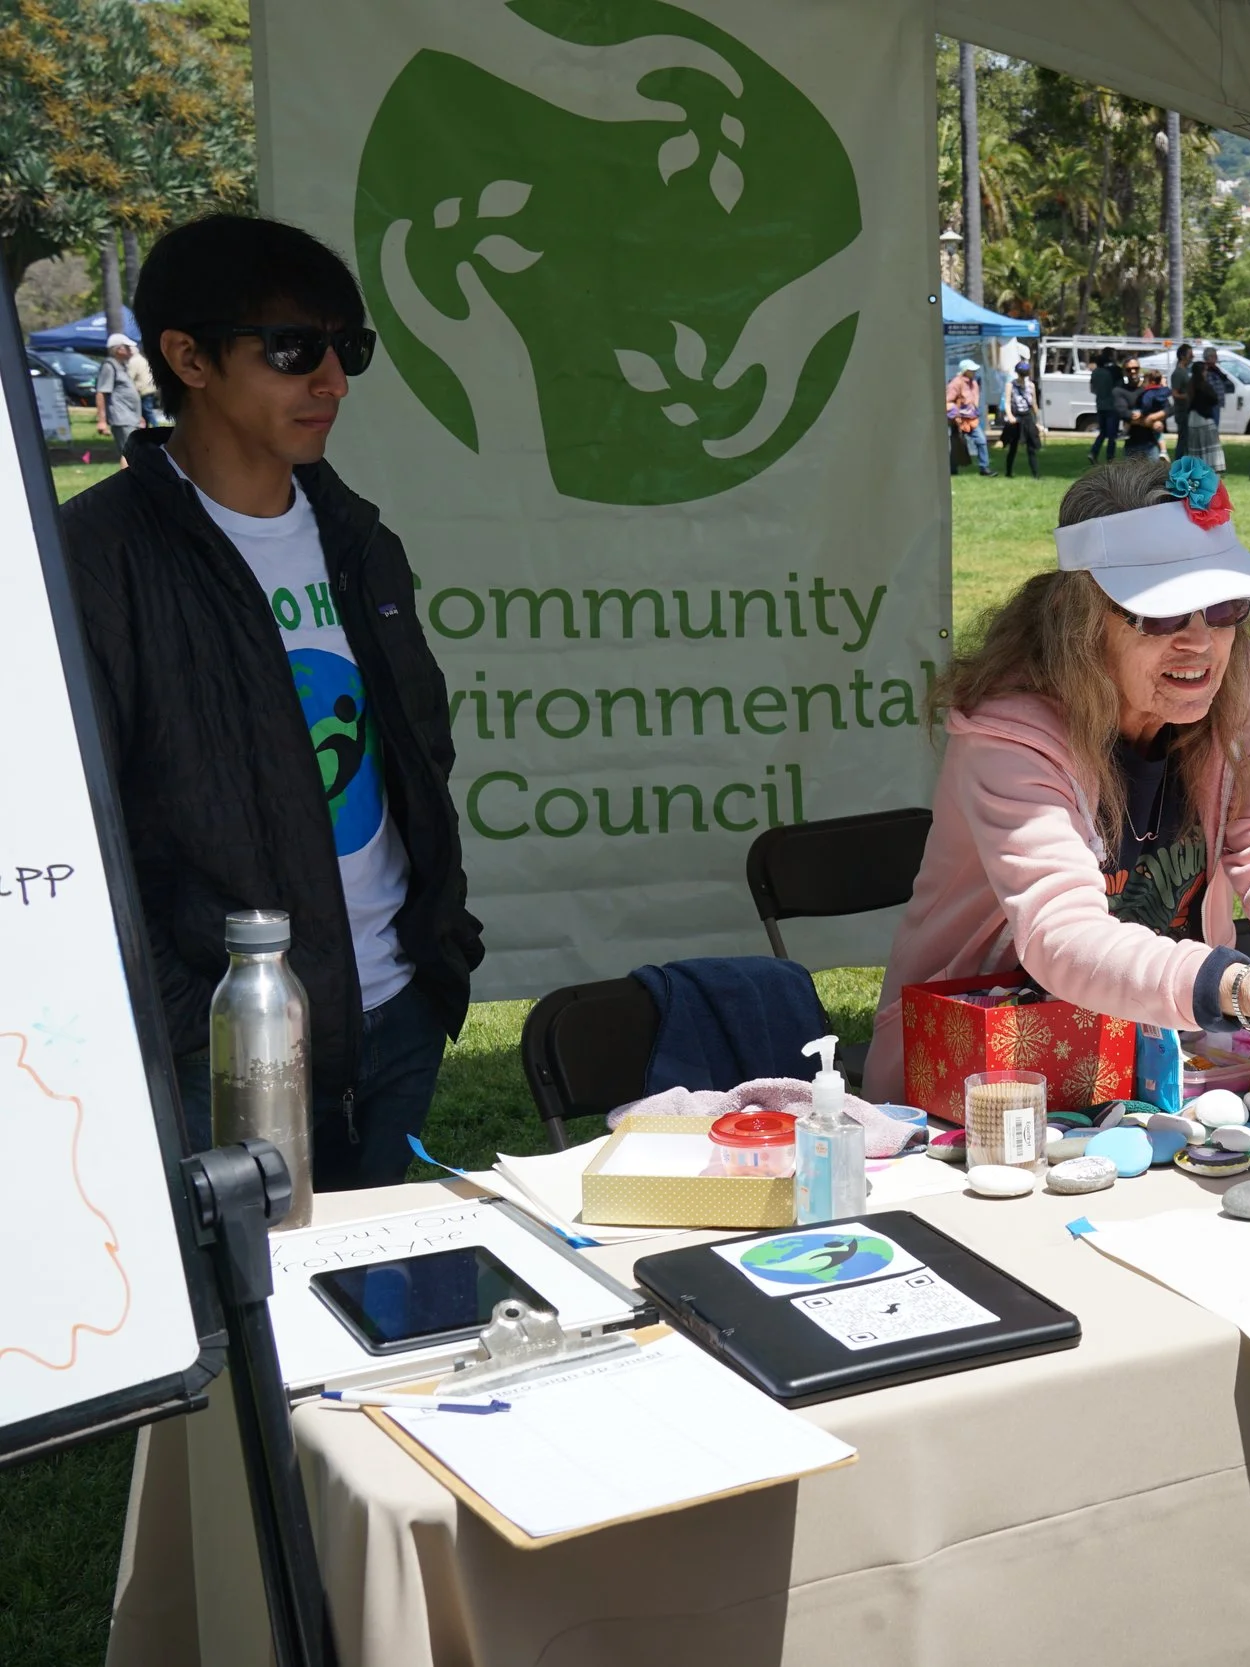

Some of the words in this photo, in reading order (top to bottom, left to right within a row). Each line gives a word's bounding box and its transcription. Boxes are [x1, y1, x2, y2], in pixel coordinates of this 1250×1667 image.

[271, 587, 302, 631] O
[304, 582, 342, 629] H
[412, 572, 887, 653] ommunity
[449, 661, 944, 740] ironmental
[466, 763, 809, 841] Council
[315, 1226, 391, 1247] Out
[413, 1210, 484, 1228] Our
[536, 1371, 580, 1389] Sign
[613, 1350, 665, 1368] Sheet
